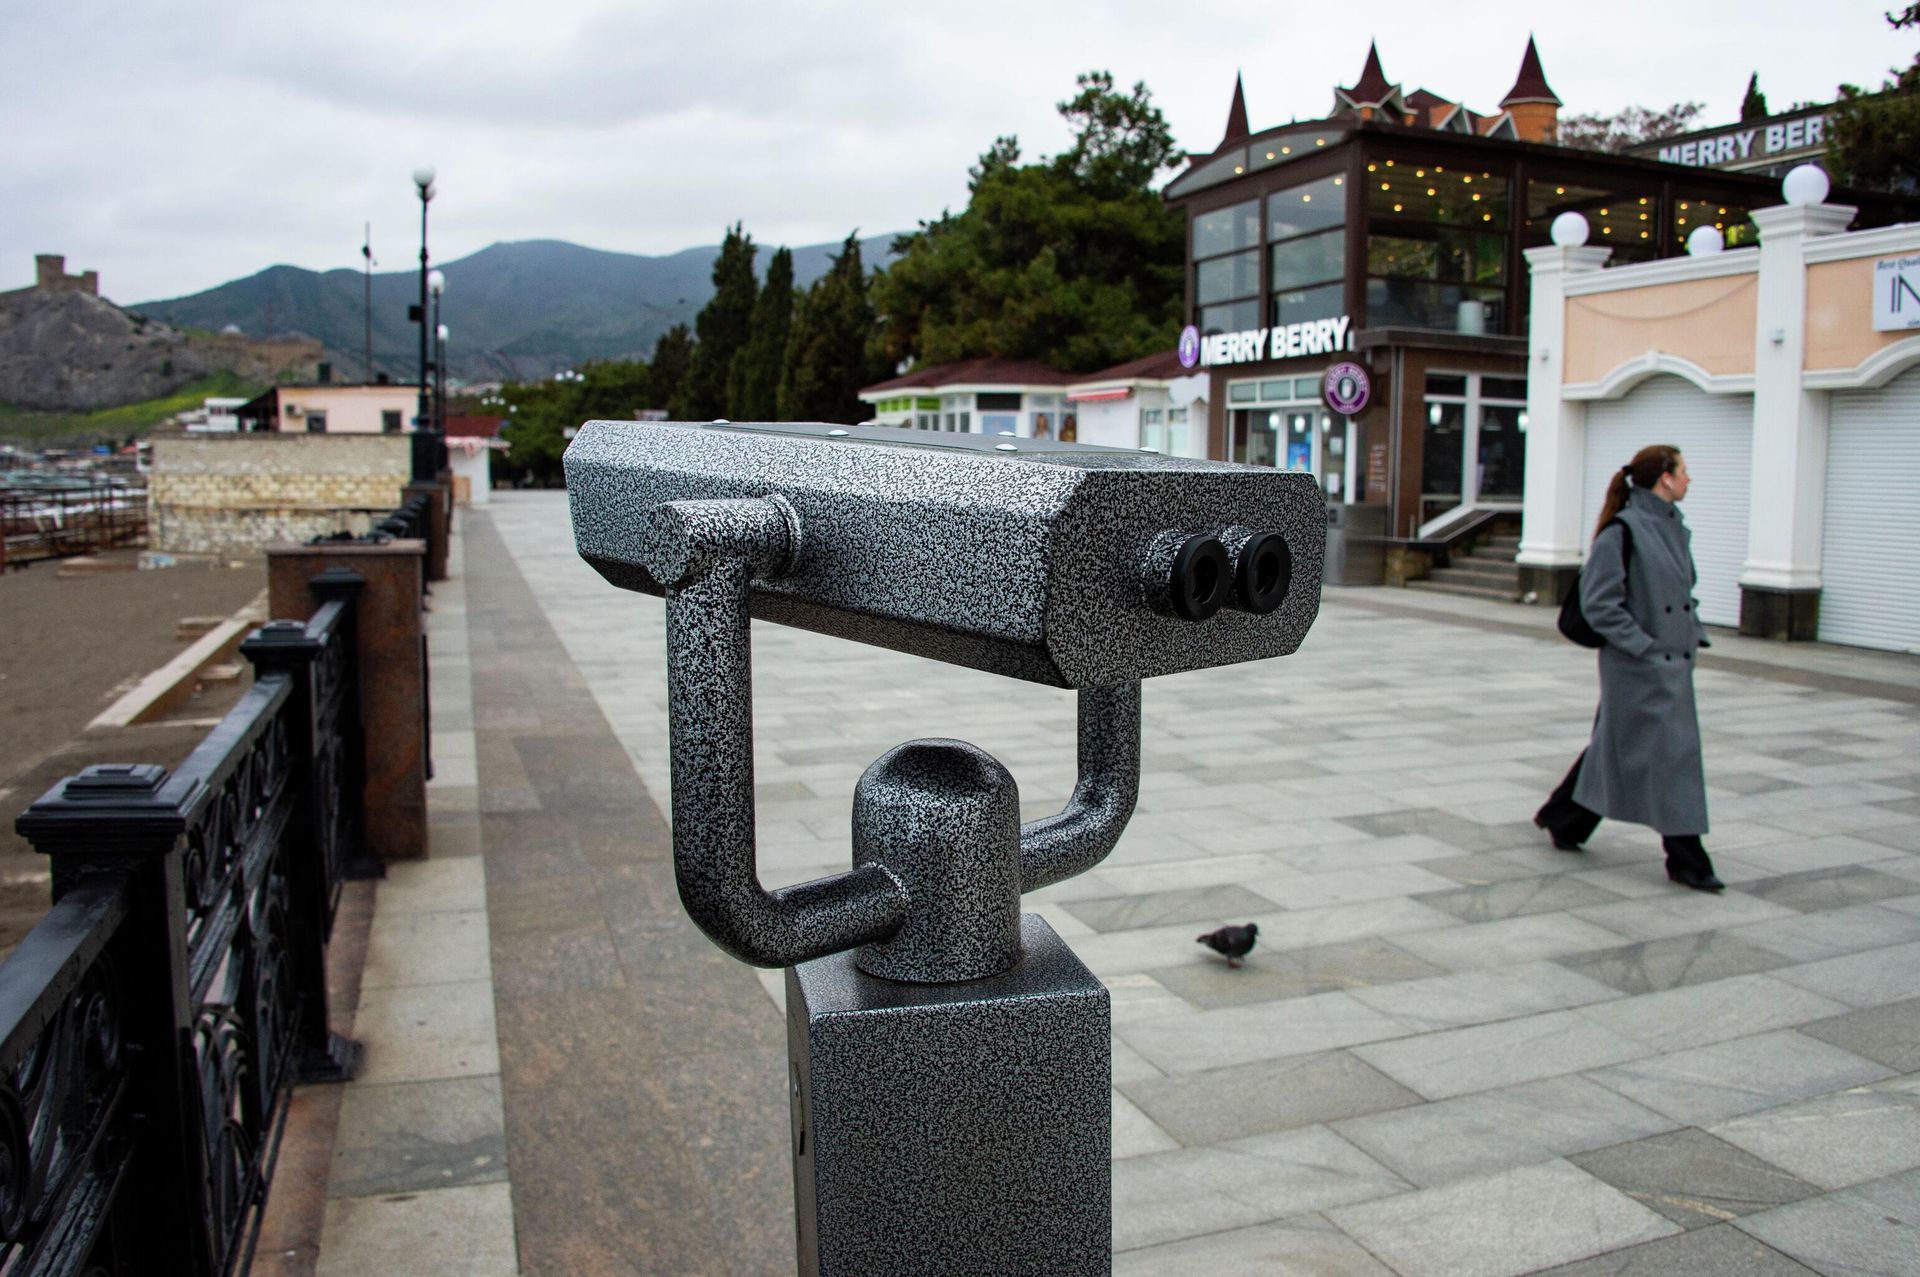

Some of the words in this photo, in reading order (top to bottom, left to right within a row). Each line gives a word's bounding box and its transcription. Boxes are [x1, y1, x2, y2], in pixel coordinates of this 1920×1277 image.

[1658, 129, 1755, 167] MERRY
[1765, 115, 1836, 152] BER
[1200, 328, 1268, 367] MERRY
[1271, 315, 1350, 359] BERRY
